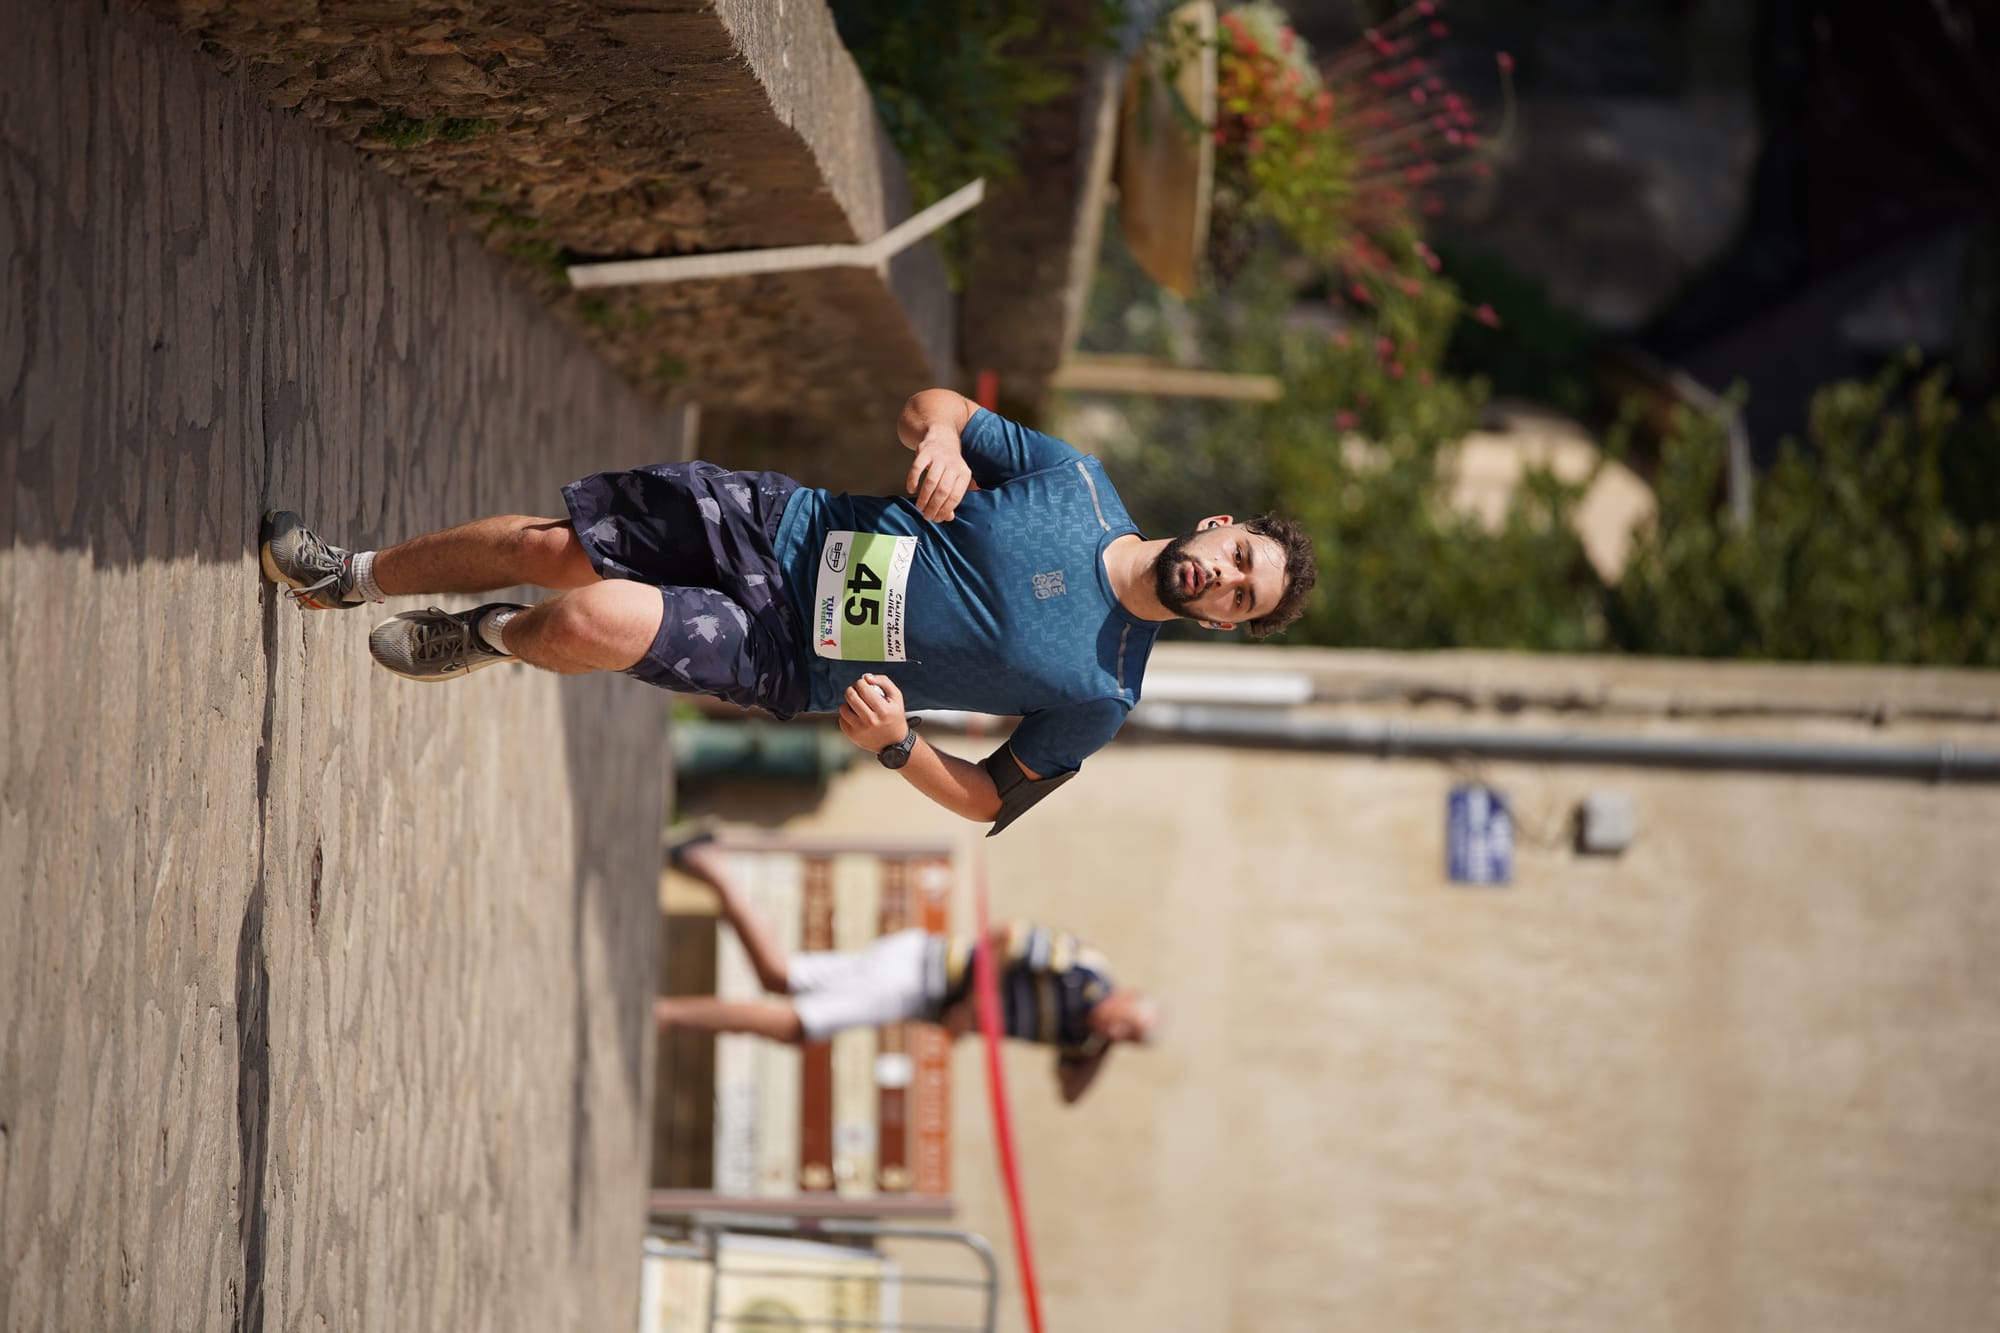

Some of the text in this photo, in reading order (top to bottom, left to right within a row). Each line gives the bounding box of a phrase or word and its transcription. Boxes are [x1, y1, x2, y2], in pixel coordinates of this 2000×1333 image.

[832, 542, 843, 568] BFP
[844, 563, 882, 626] 45
[893, 593, 903, 635] Challenge
[825, 595, 835, 636] TUFF'S
